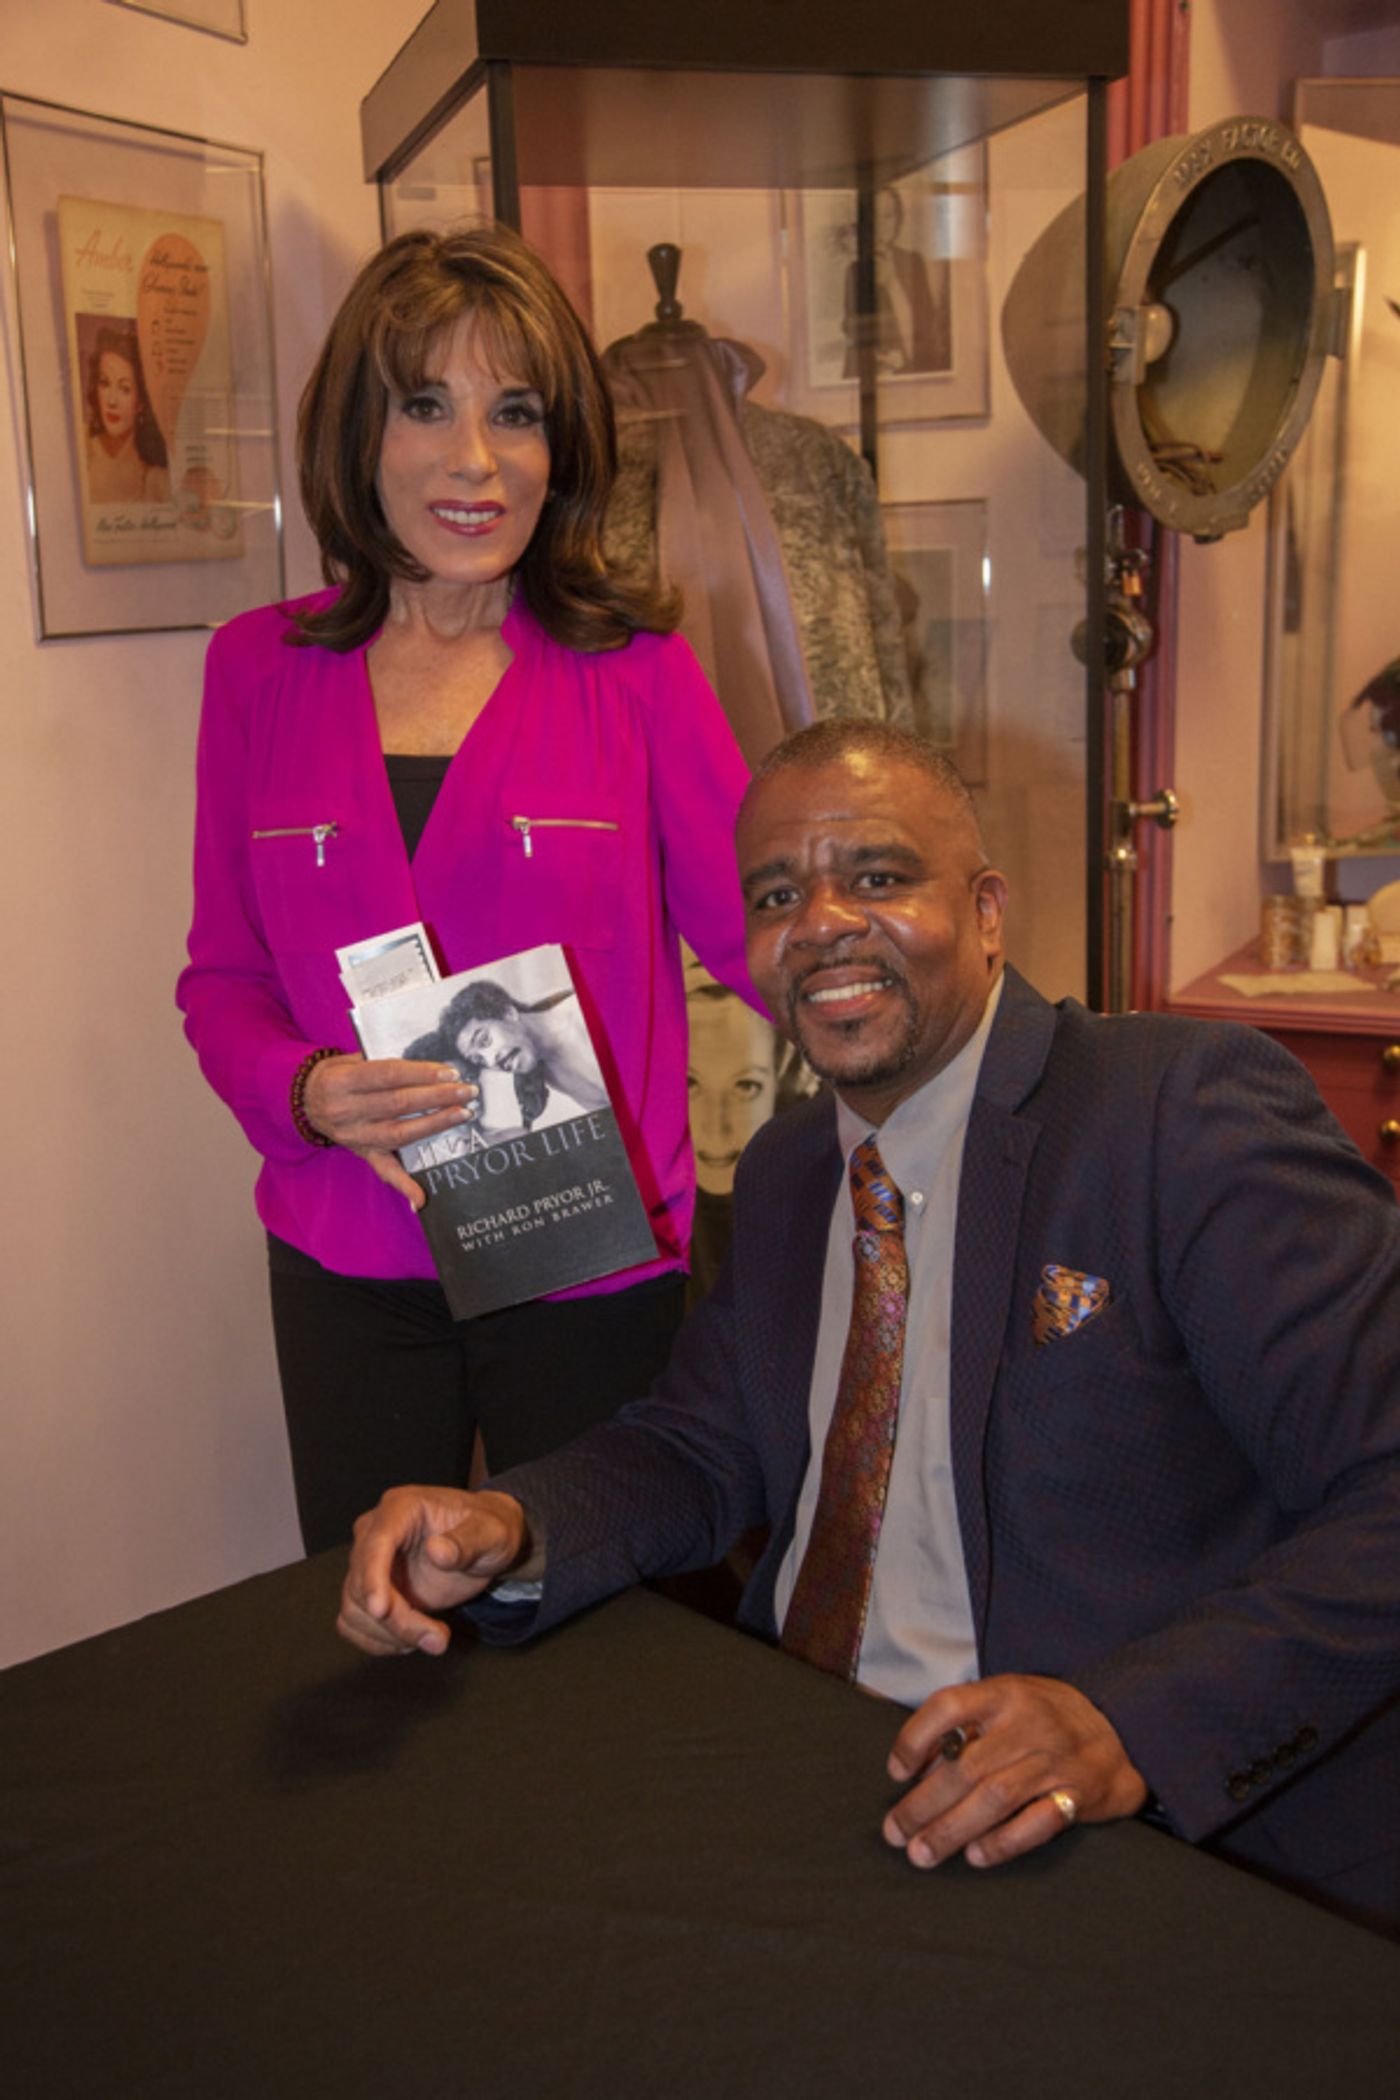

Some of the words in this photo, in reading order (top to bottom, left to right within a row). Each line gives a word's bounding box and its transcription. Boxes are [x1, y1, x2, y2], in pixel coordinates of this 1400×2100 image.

[425, 1139, 535, 1196] PRYOR
[541, 1114, 607, 1156] LIFE
[469, 1128, 490, 1153] A
[457, 1203, 531, 1240] RICHARD
[533, 1186, 584, 1215] PRYOR
[587, 1179, 611, 1199] JR.
[461, 1231, 505, 1252] WITH
[512, 1217, 546, 1236] RON
[552, 1193, 614, 1222] BRAWER
